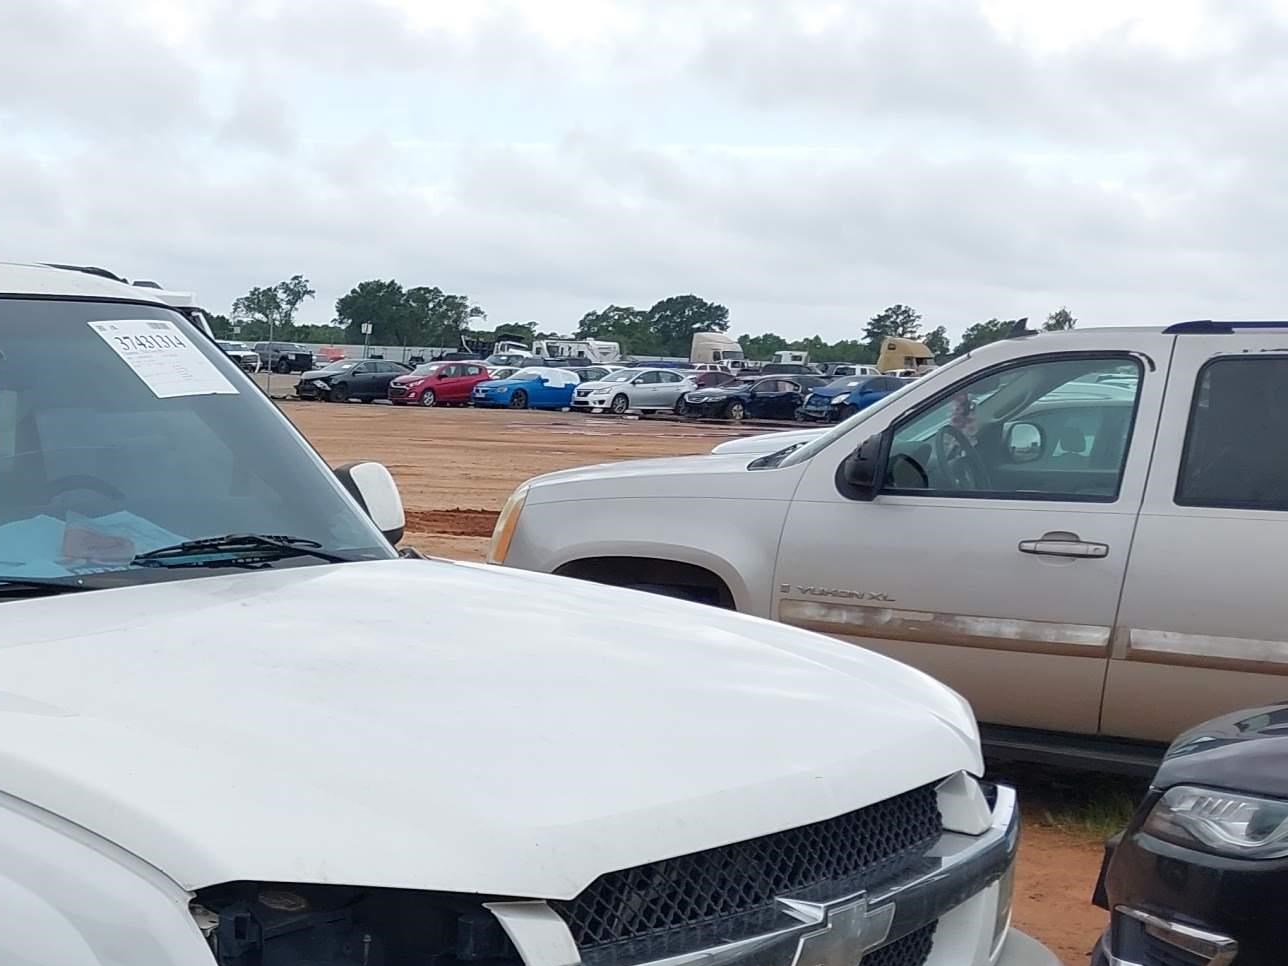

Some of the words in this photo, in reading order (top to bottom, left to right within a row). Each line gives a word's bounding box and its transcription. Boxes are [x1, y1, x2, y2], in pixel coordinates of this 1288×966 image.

[114, 335, 187, 351] 37431314
[796, 585, 865, 600] YUKON
[867, 591, 897, 602] XL
